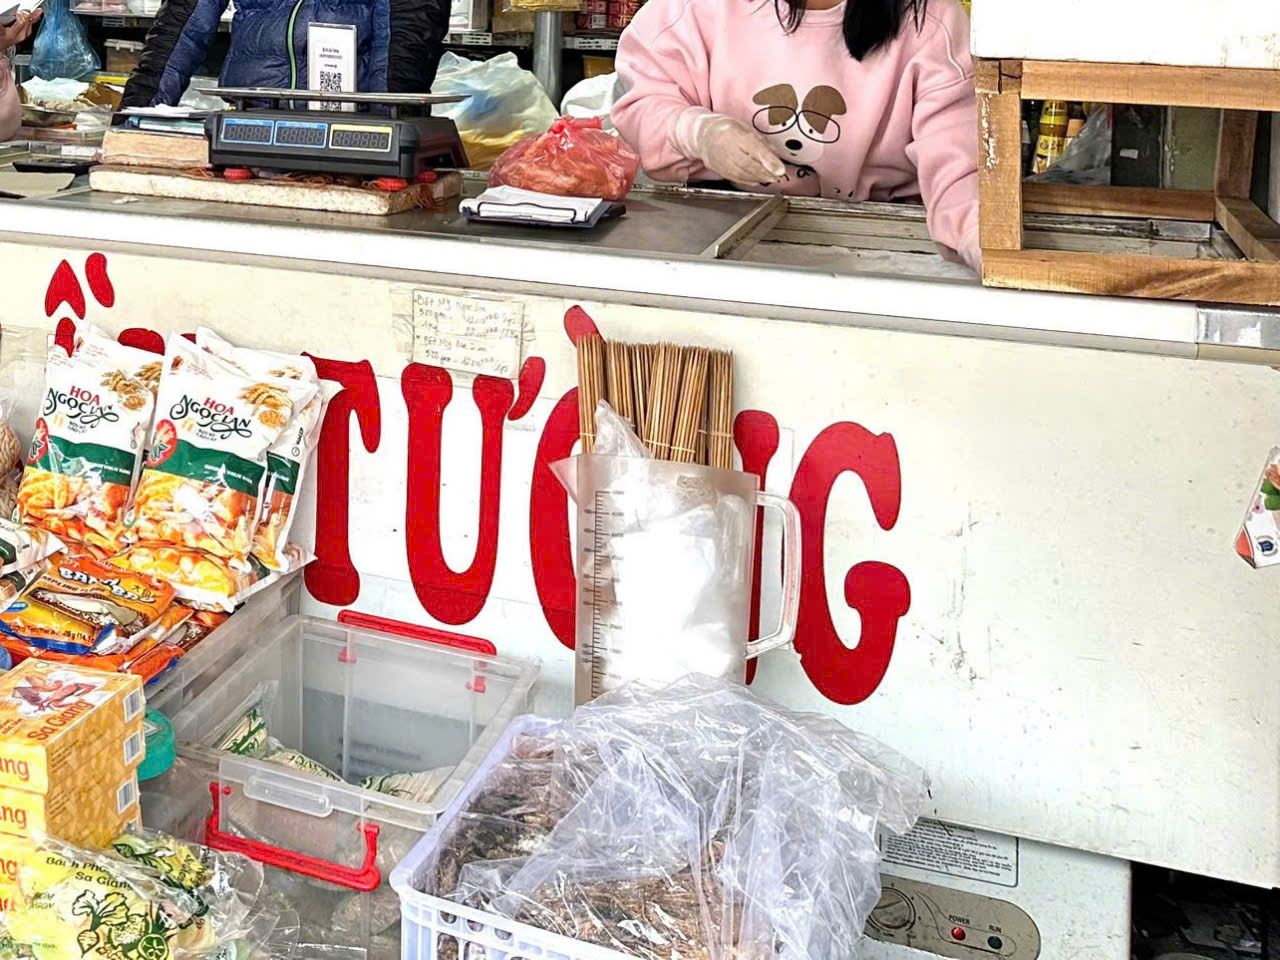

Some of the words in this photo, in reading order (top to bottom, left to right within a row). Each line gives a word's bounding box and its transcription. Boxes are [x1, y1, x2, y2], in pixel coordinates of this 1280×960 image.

[43, 387, 87, 418] NGỌC
[69, 385, 101, 406] HOA
[203, 396, 235, 416] HOA
[170, 394, 220, 427] NGỌC
[211, 414, 253, 440] LAN
[28, 722, 51, 740] Sa
[49, 701, 94, 727] Giang
[75, 871, 93, 882] Sa
[948, 913, 971, 925] POWER
[988, 924, 1003, 934] RUN
